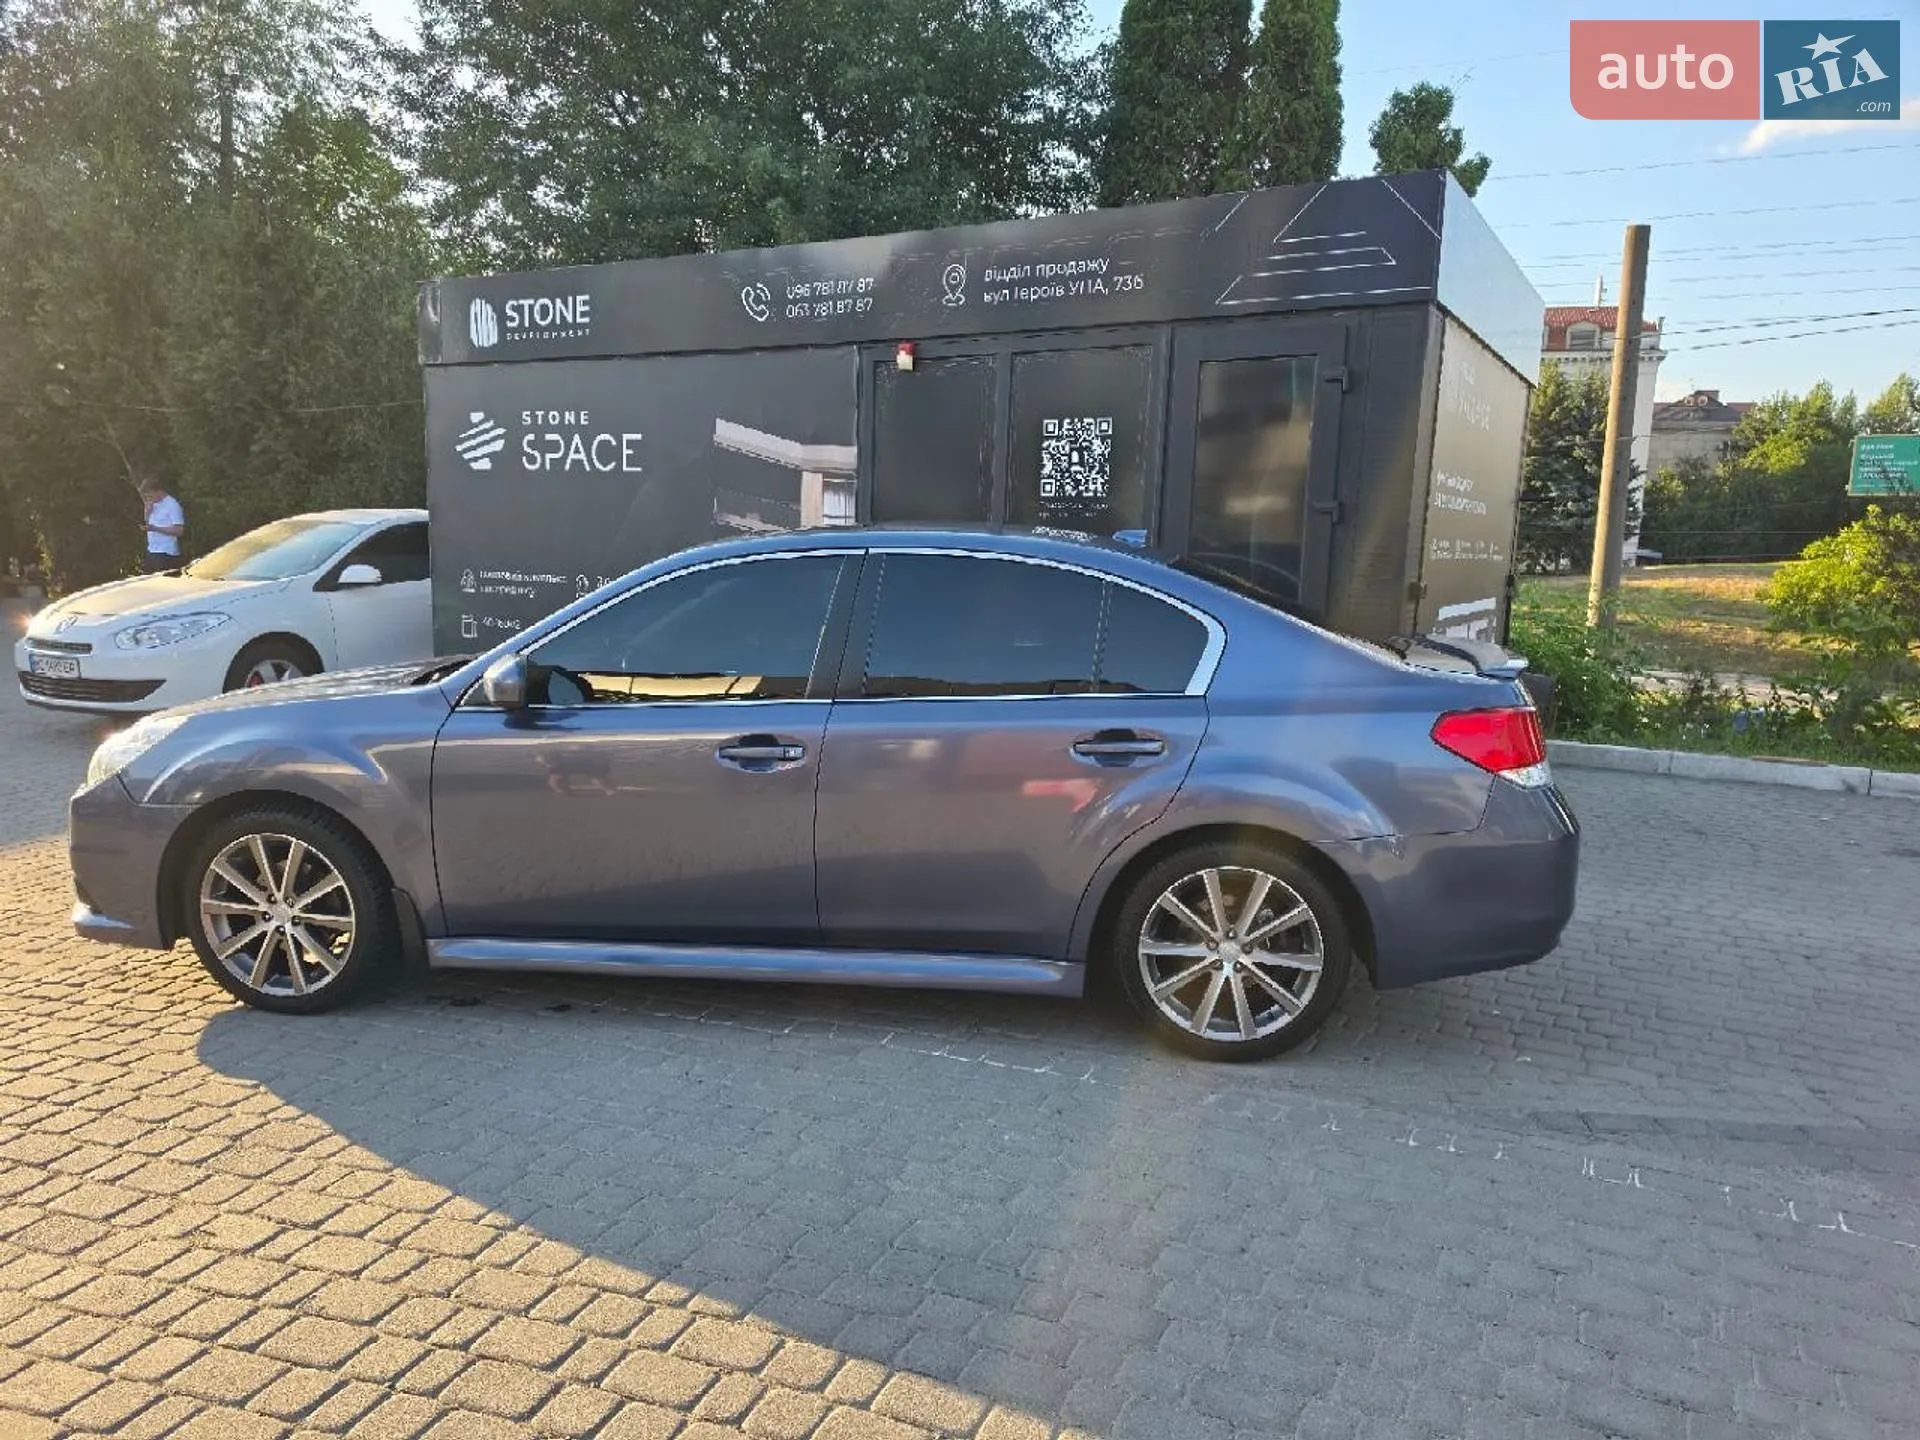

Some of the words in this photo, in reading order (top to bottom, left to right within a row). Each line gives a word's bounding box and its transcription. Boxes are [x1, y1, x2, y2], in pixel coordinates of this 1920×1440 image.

[1036, 257, 1110, 279] продажу
[505, 294, 591, 328] STONE
[522, 410, 590, 425] STONE
[522, 433, 642, 471] SPACE
